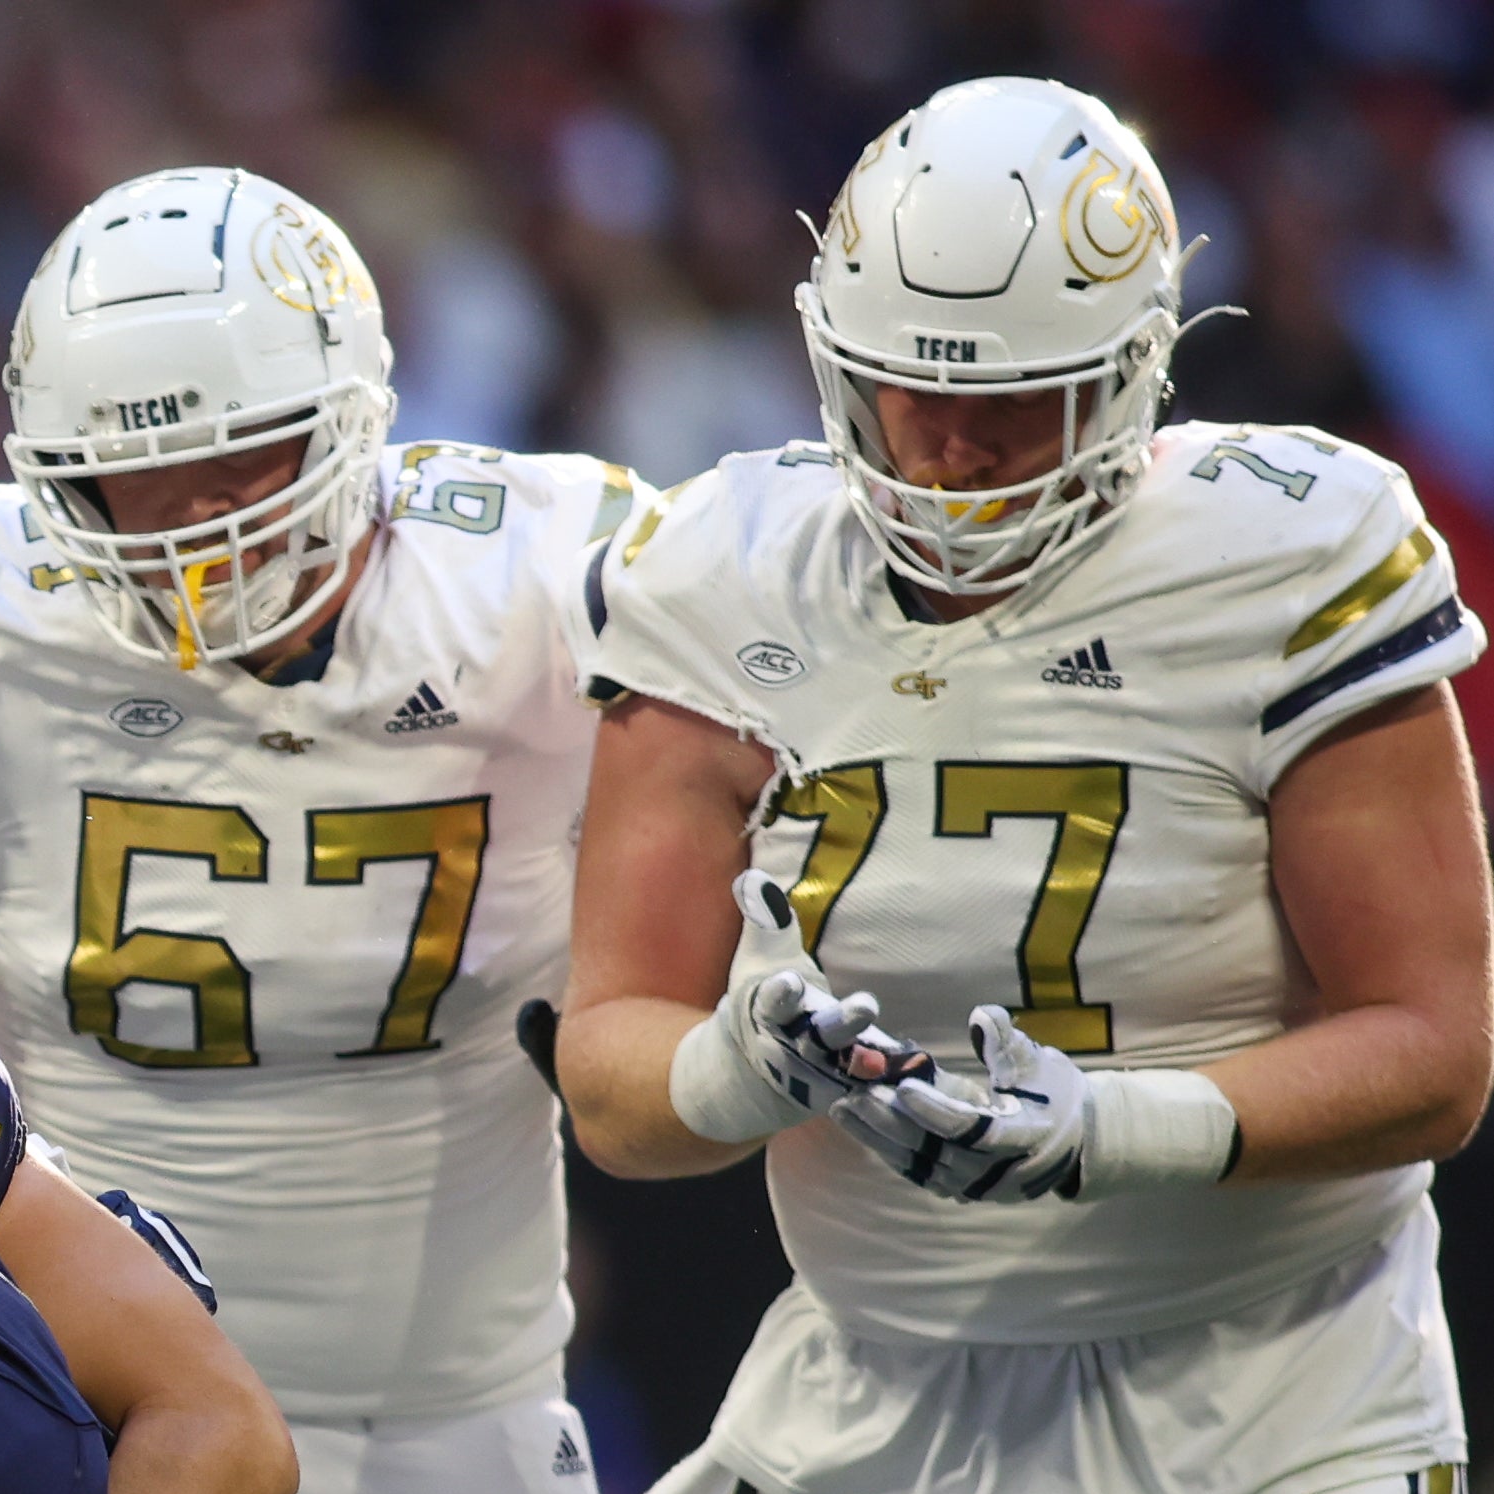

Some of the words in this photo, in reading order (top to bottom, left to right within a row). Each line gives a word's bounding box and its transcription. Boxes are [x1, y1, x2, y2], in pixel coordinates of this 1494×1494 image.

[914, 334, 978, 364] TECH
[118, 393, 181, 431] TECH
[748, 650, 798, 673] ACC
[1041, 663, 1125, 692] adidas
[120, 704, 172, 728] ACC
[384, 709, 459, 735] adidas
[63, 788, 491, 1070] 67
